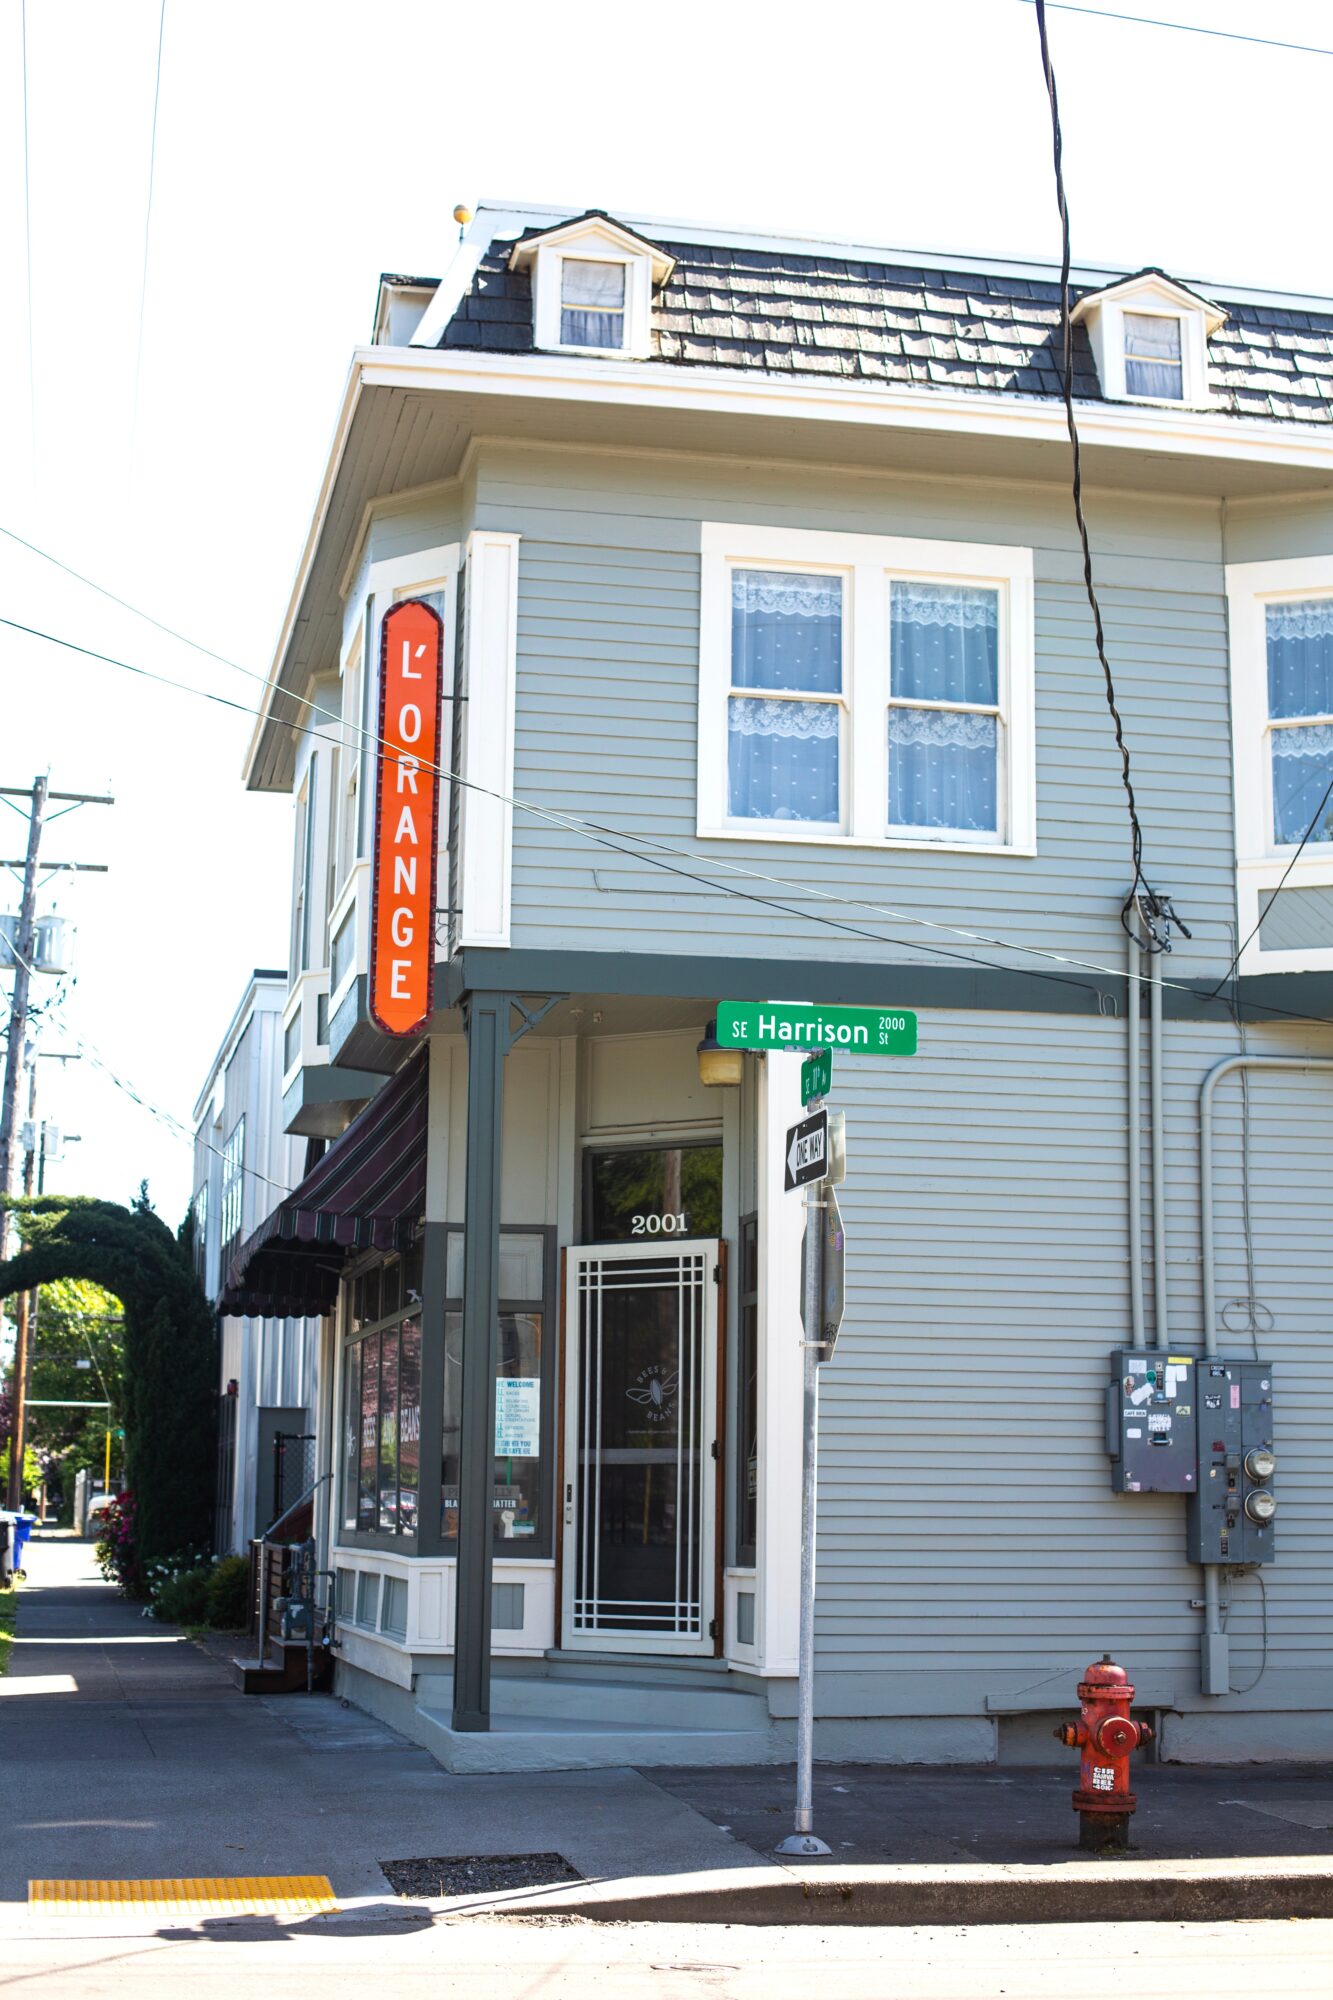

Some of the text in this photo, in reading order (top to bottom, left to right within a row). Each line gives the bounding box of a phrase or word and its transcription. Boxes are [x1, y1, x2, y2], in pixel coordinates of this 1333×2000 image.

[391, 640, 426, 999] L'ORANGE
[732, 1015, 888, 1045] SE Harrison St
[879, 1017, 905, 1031] 2000
[796, 1132, 822, 1167] ONE WAY
[631, 1213, 688, 1235] 2001
[637, 1365, 659, 1383] BEES
[400, 1405, 420, 1443] BEANS
[647, 1402, 675, 1422] BEANS
